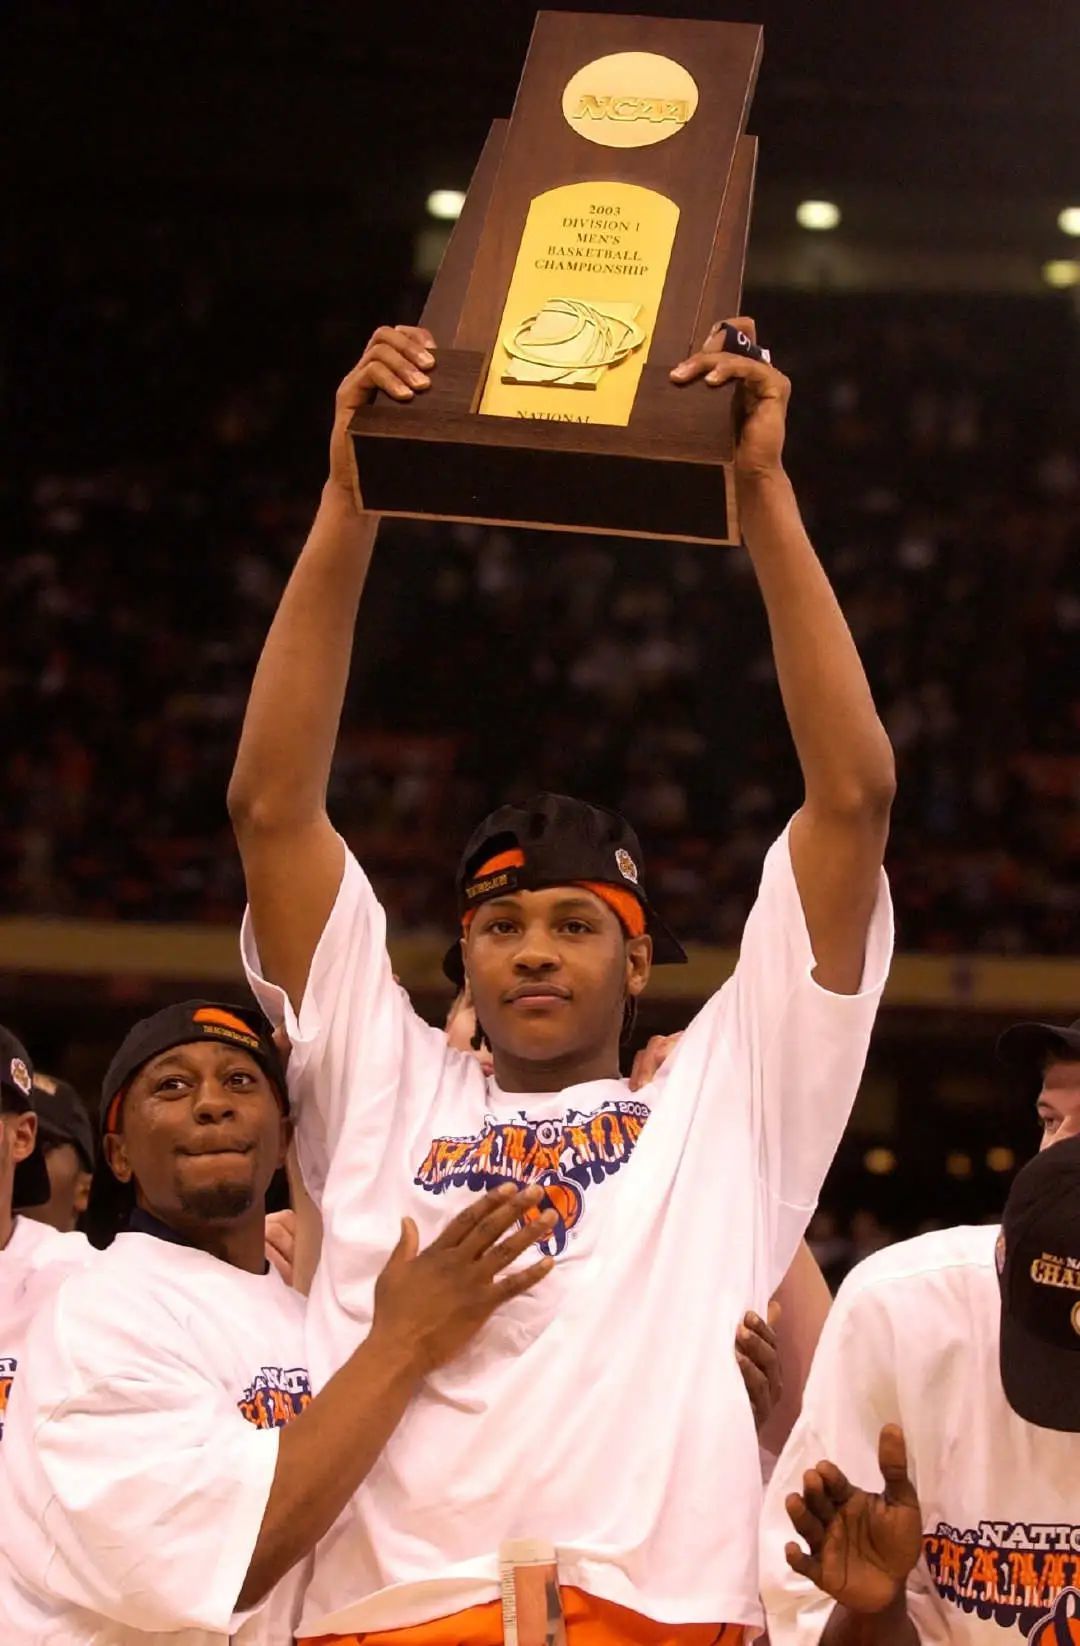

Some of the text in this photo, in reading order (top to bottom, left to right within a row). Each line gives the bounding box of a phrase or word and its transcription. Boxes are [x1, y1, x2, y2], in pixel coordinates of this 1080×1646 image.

[572, 95, 688, 124] NCAA
[589, 204, 621, 216] 2003
[562, 217, 629, 231] DIVISION
[577, 233, 621, 245] MEN'S
[547, 245, 642, 261] BASKETBALL
[534, 259, 649, 276] CHAMPIONSHIP
